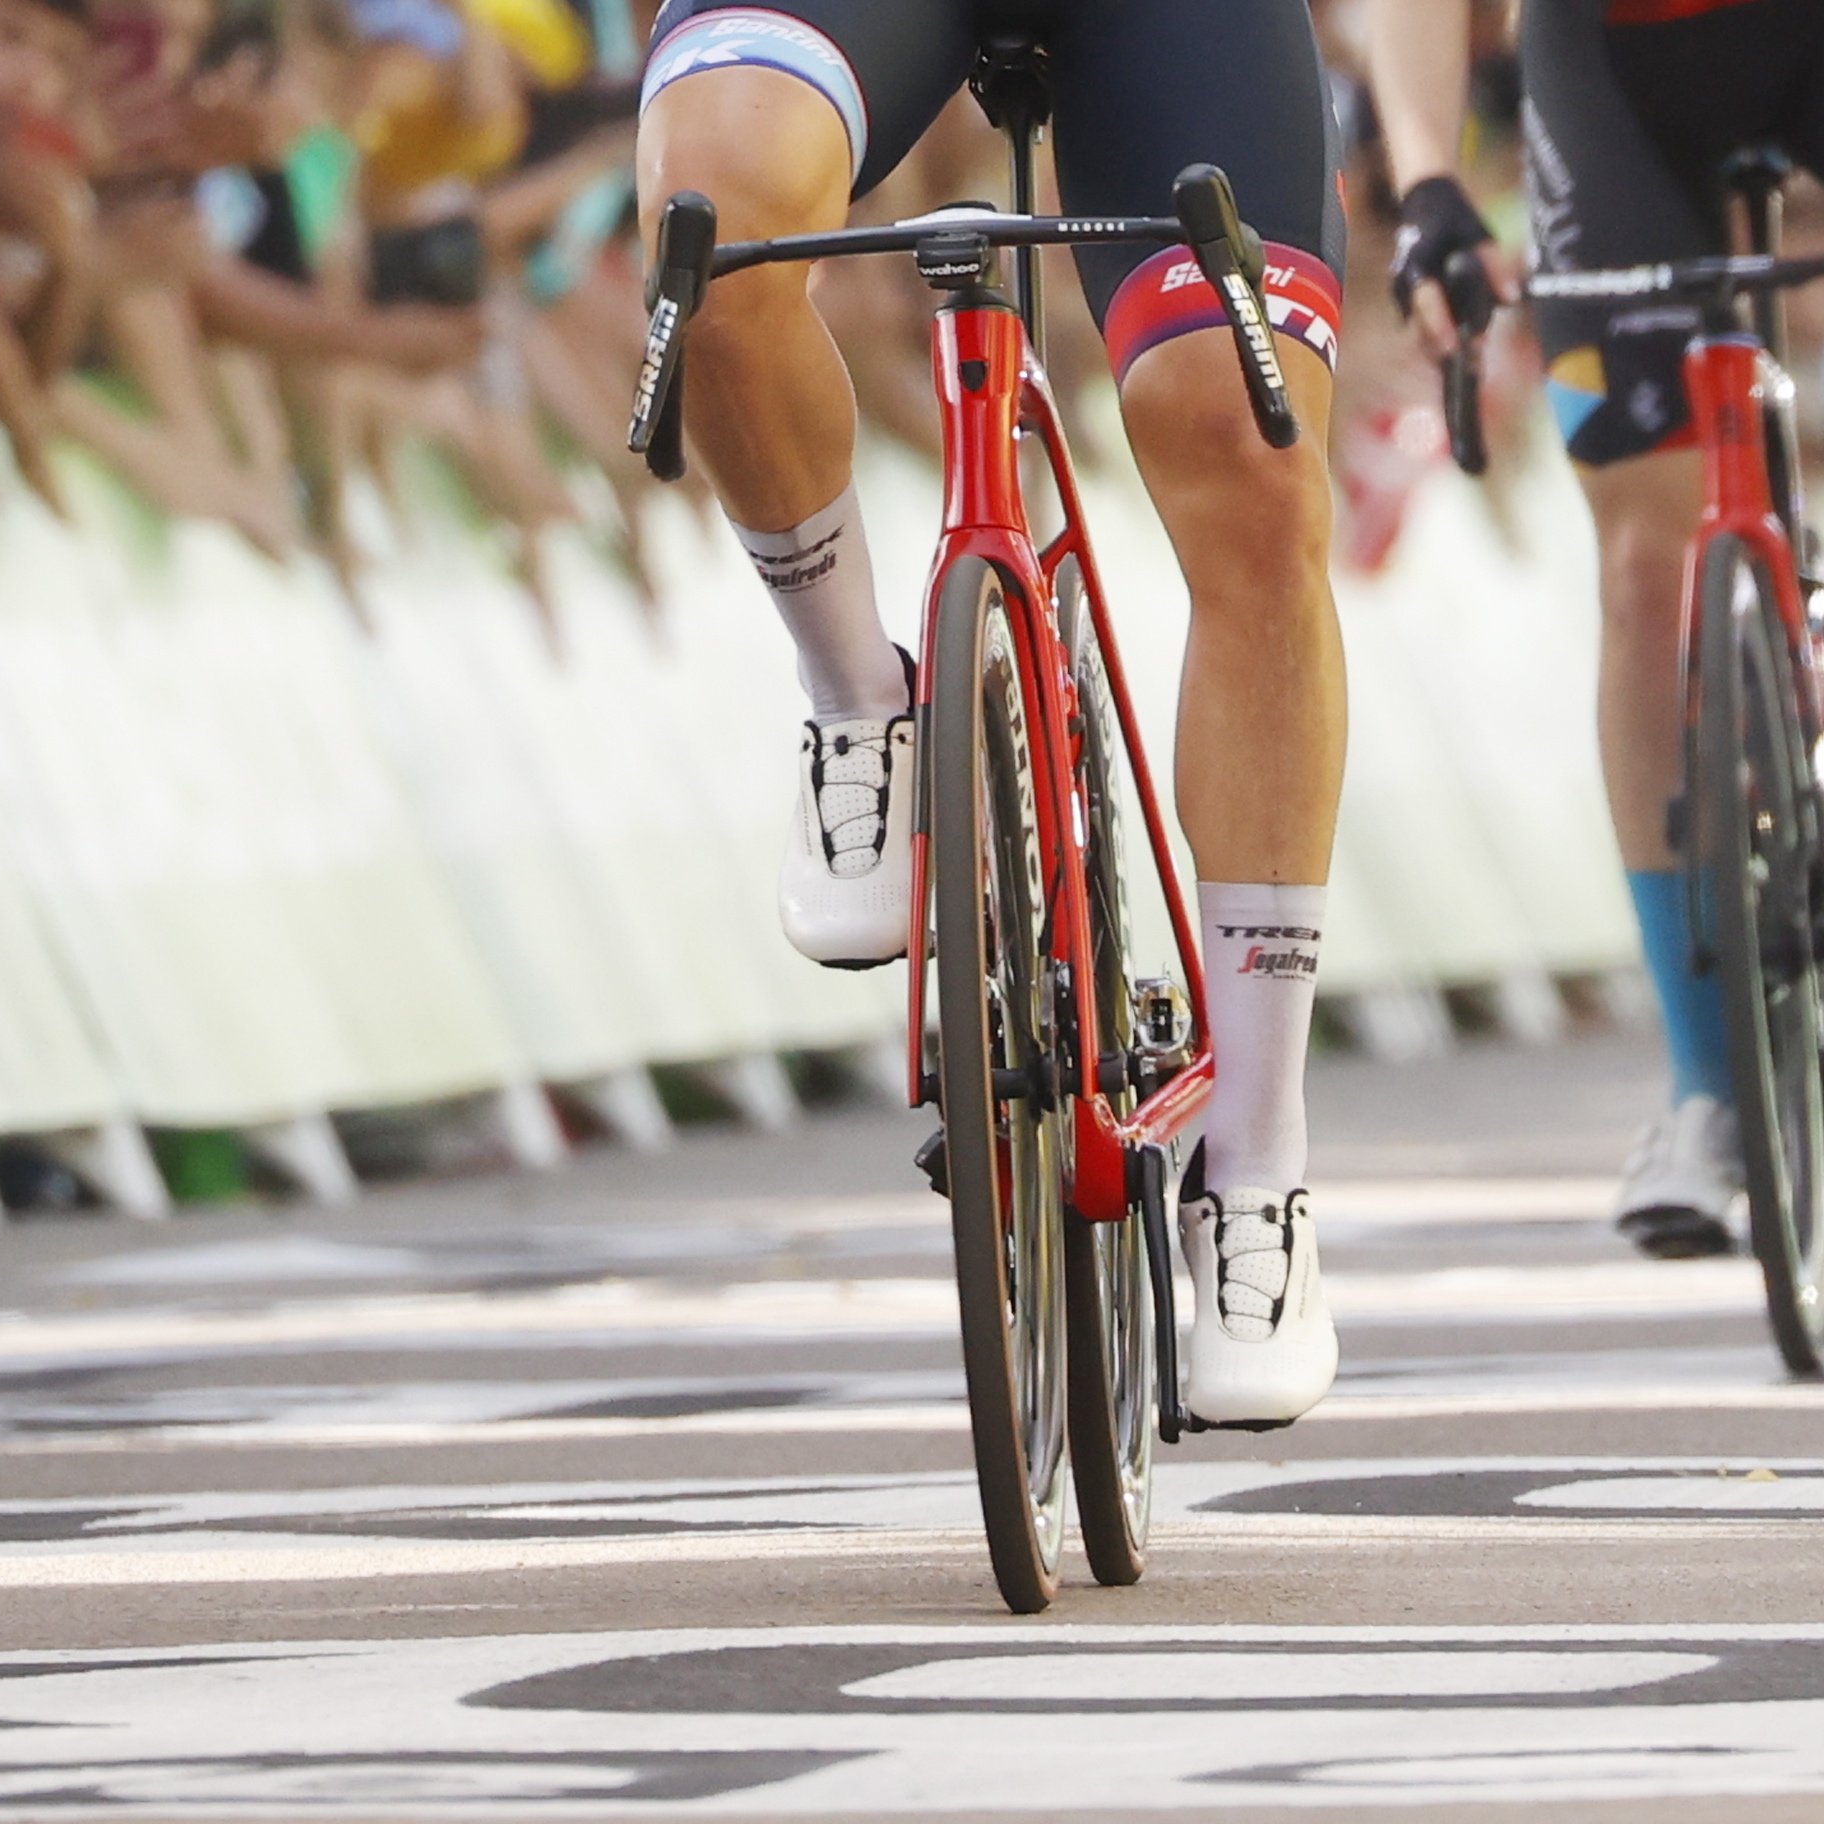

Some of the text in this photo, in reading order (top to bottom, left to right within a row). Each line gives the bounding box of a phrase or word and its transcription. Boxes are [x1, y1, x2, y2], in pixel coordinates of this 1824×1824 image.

[920, 262, 980, 276] wahoo
[1160, 260, 1296, 293] Sani
[633, 298, 679, 422] SRAM
[1222, 272, 1284, 389] SRAM
